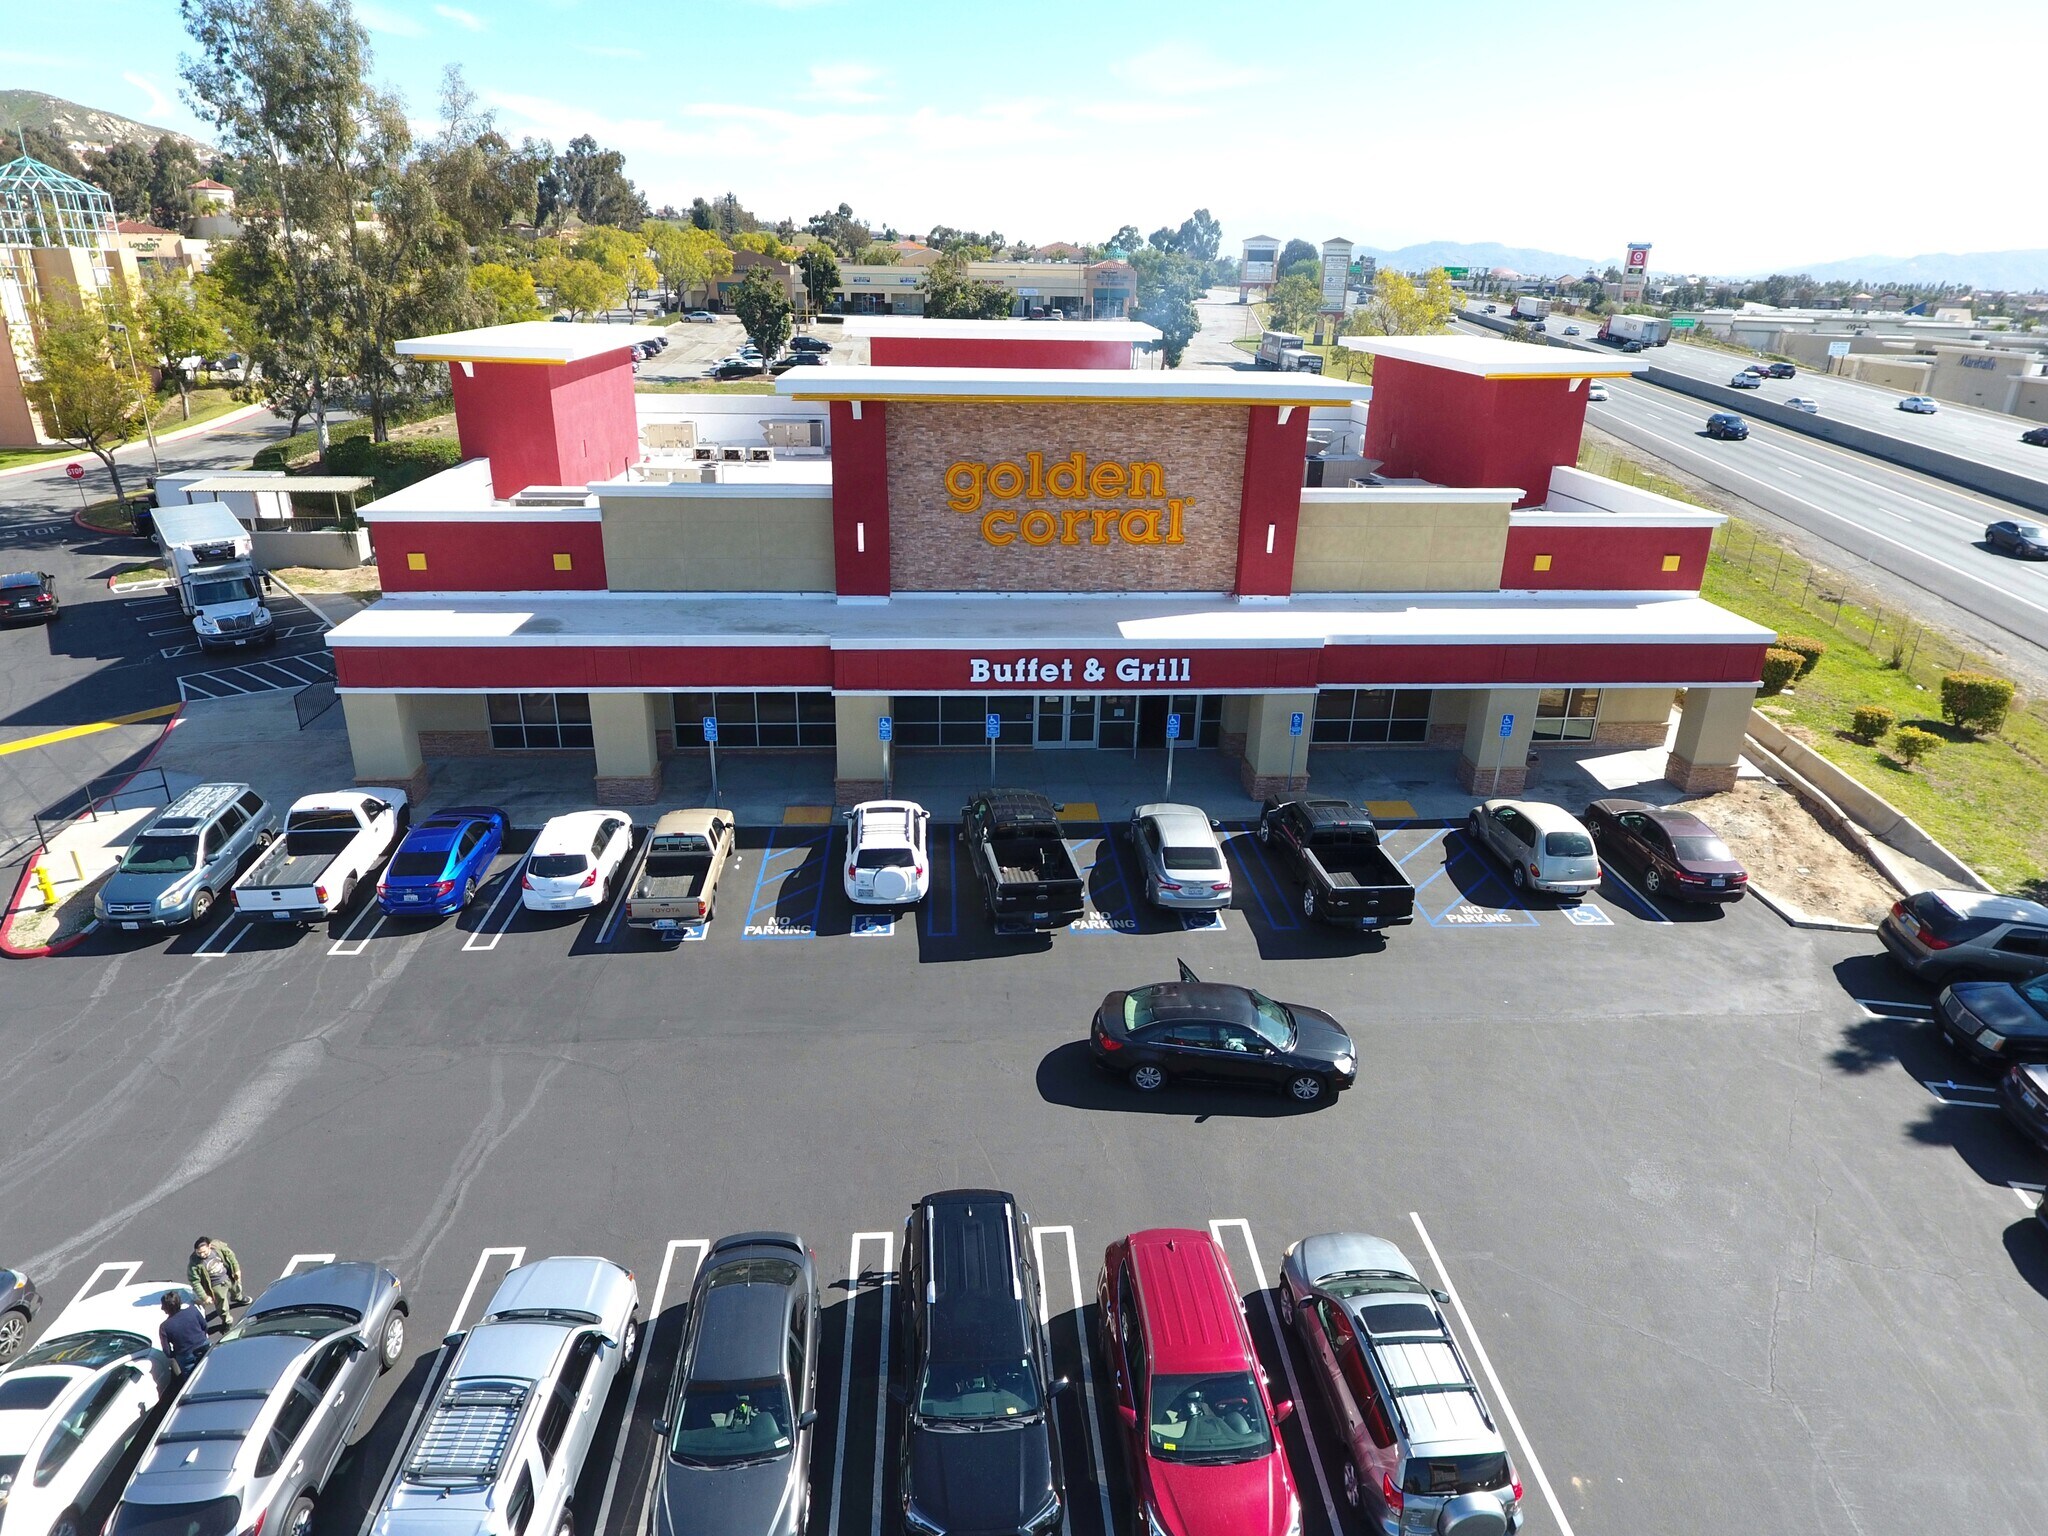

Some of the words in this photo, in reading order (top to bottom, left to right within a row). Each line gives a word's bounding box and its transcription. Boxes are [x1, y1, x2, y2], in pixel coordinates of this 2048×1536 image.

[67, 467, 83, 475] STOP
[945, 452, 1166, 513] golden
[981, 498, 1185, 545] corral
[4, 526, 62, 538] STOP
[970, 658, 1073, 682] Buffet
[1083, 658, 1105, 682] &
[1116, 658, 1190, 682] Grill
[1459, 905, 1484, 914] NO
[1089, 911, 1112, 920] NO
[1445, 914, 1512, 923] PARKING
[768, 916, 791, 926] NO
[1070, 920, 1136, 930] PARKING
[744, 925, 811, 935] PARKING
